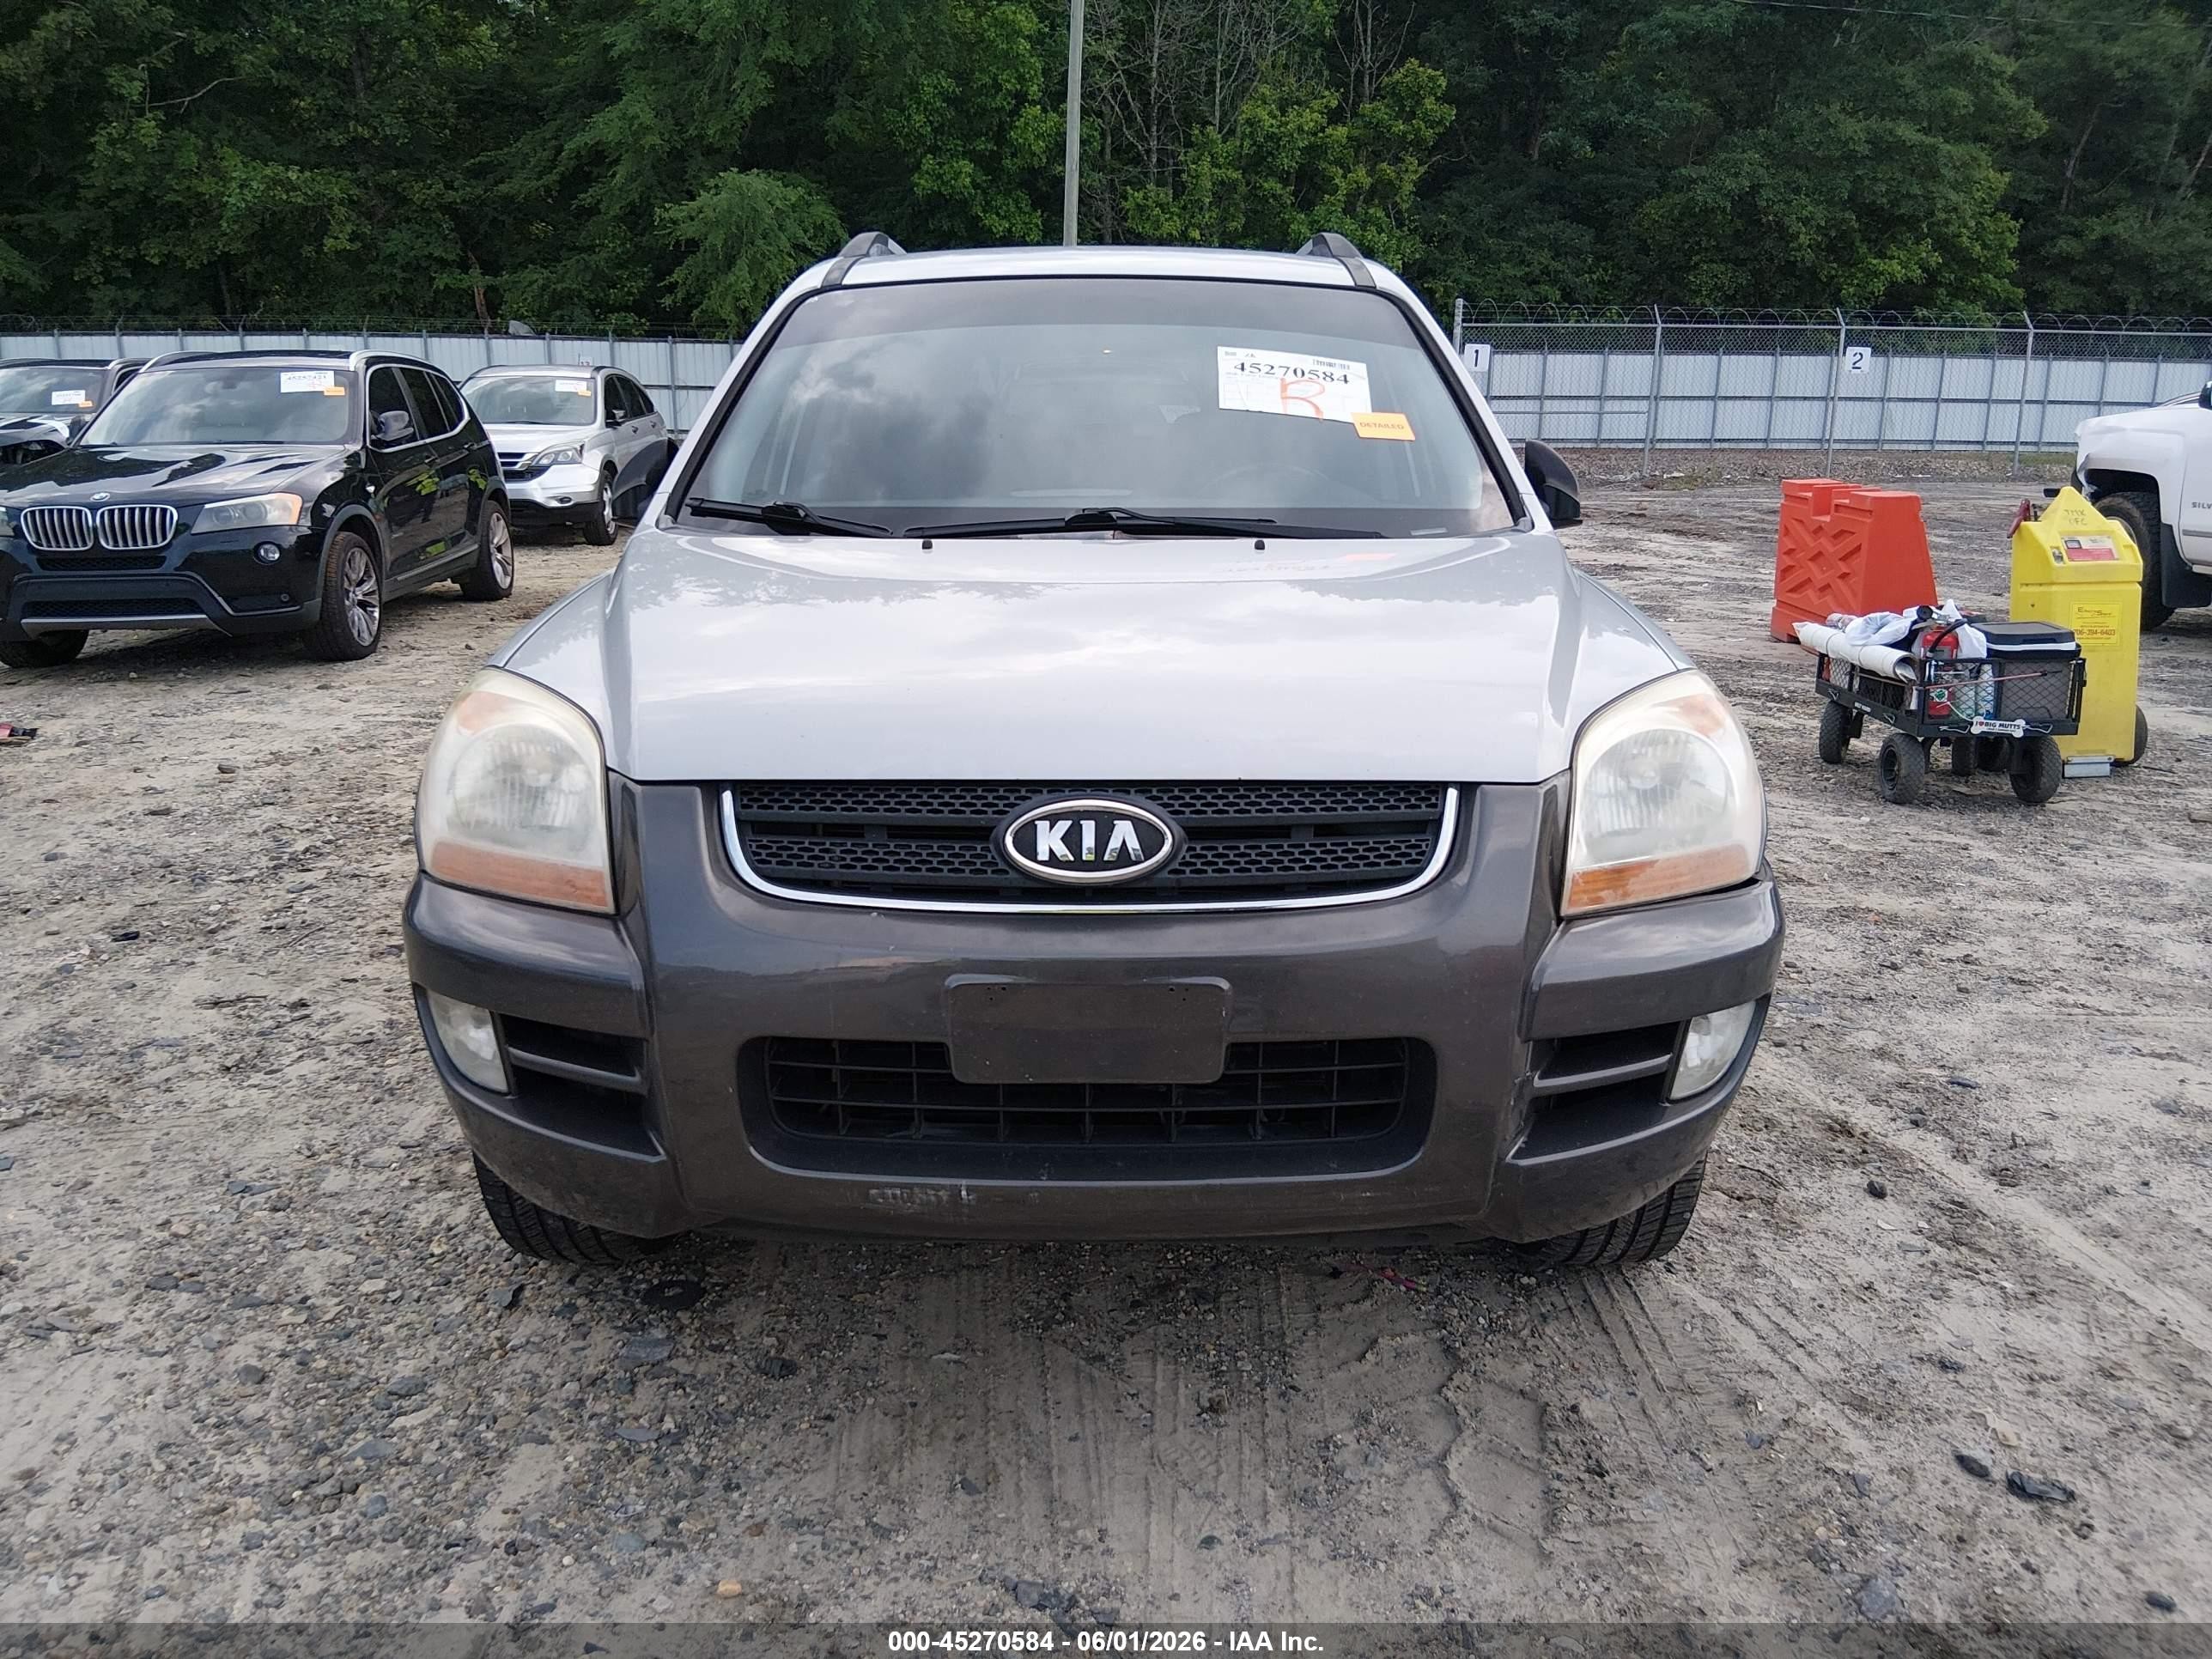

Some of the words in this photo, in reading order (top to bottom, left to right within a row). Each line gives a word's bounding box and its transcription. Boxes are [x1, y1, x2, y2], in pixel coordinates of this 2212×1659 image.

[1474, 349, 1480, 368] 1
[1851, 352, 1863, 369] 2
[1233, 361, 1350, 385] 45270584
[1035, 820, 1145, 861] KIA
